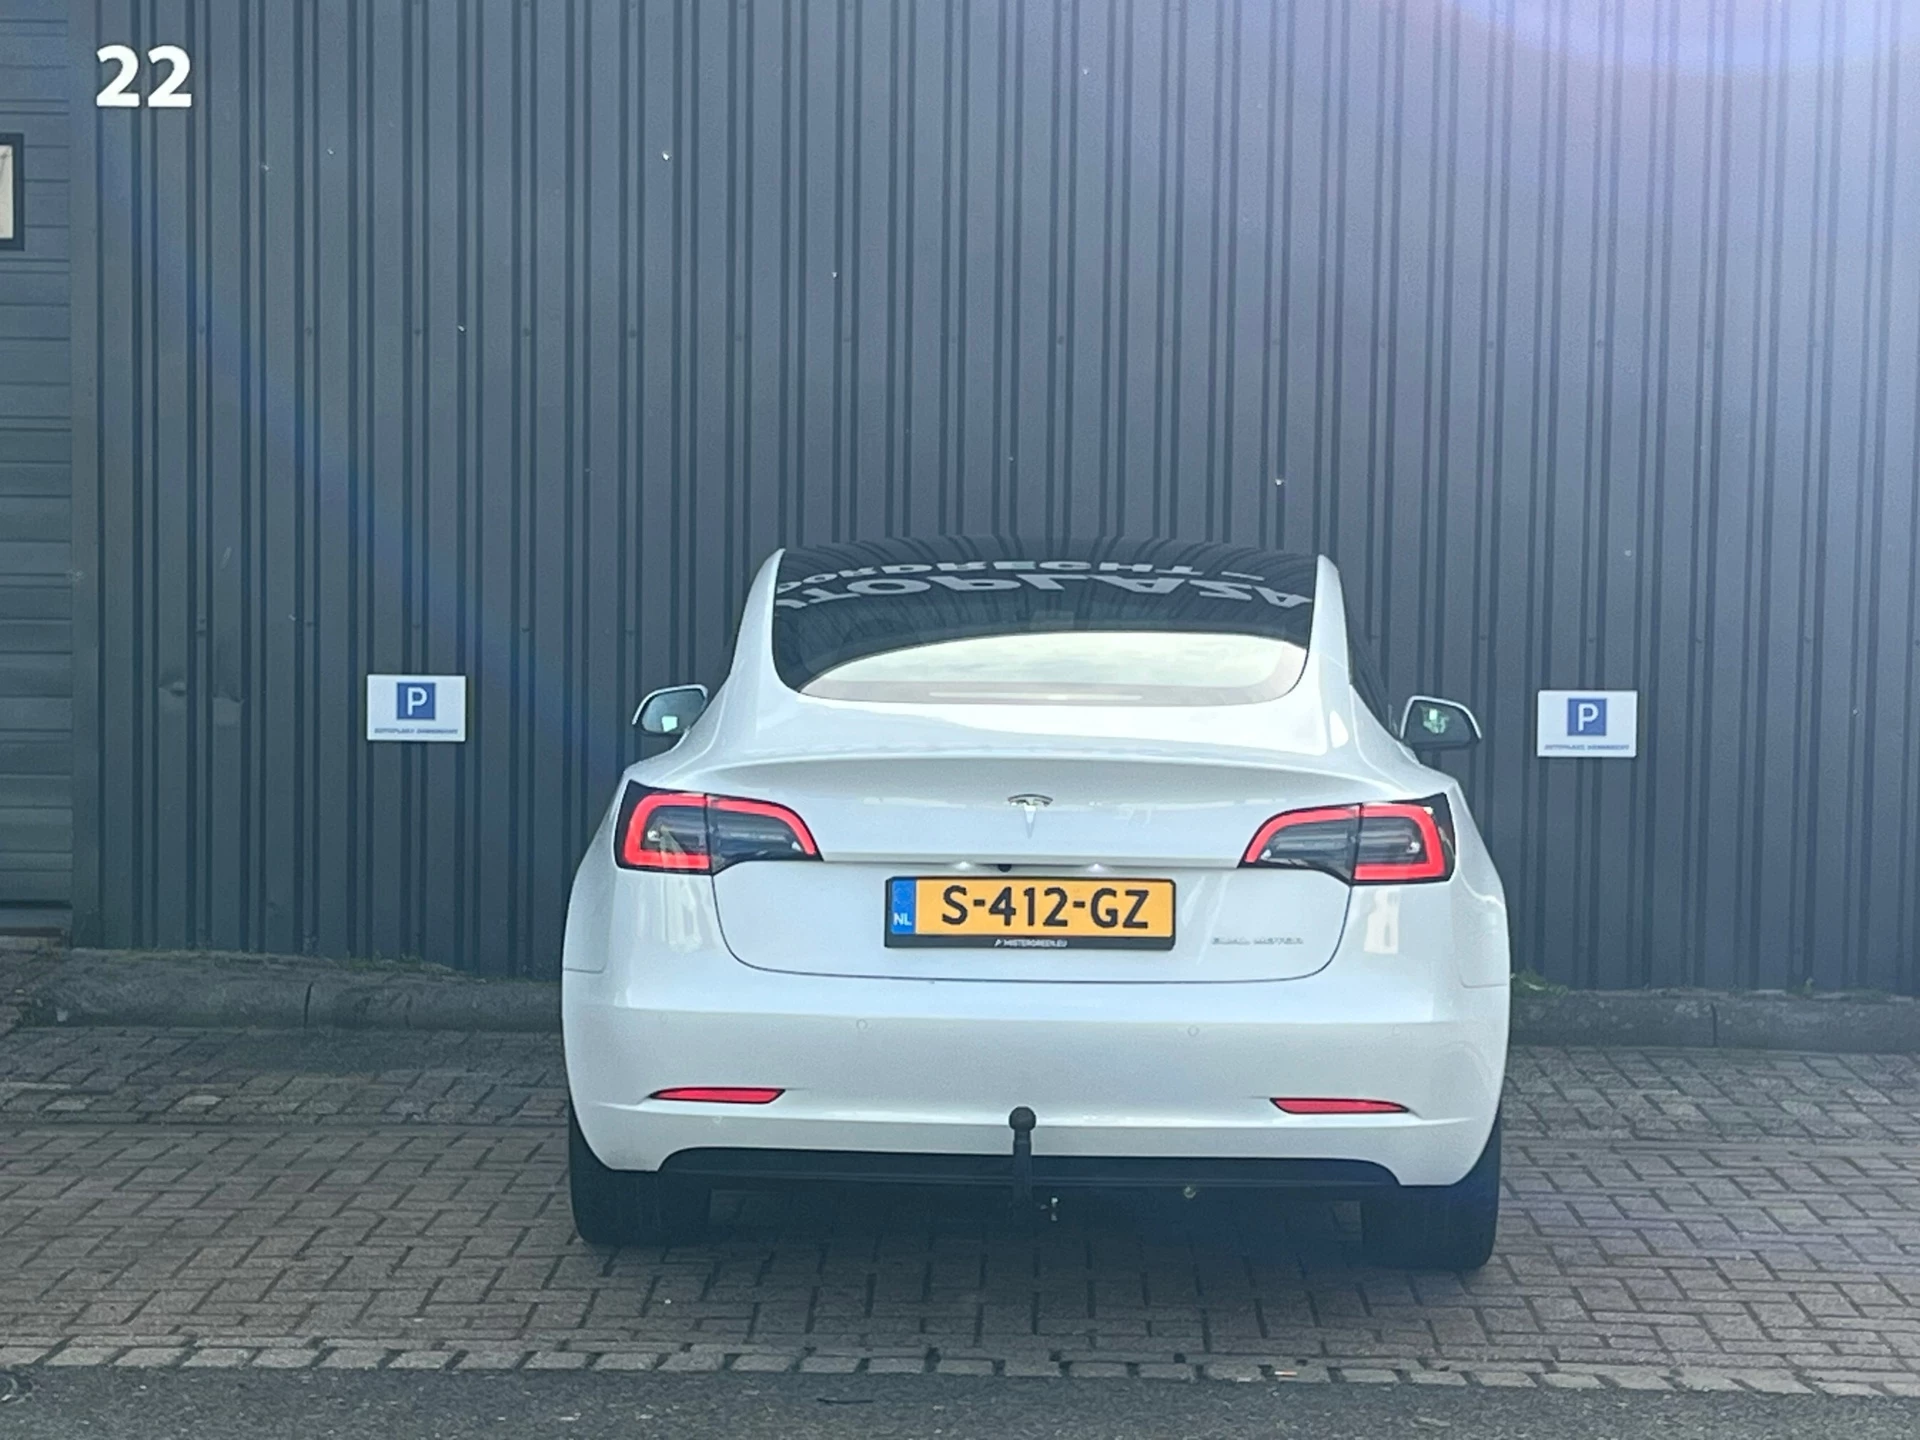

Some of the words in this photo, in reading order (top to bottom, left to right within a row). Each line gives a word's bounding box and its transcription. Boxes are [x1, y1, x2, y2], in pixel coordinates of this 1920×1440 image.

[96, 44, 192, 107] 22
[407, 687, 428, 716] P
[1578, 703, 1599, 732] P
[893, 913, 912, 926] NL
[941, 885, 1150, 929] S-412-GZ
